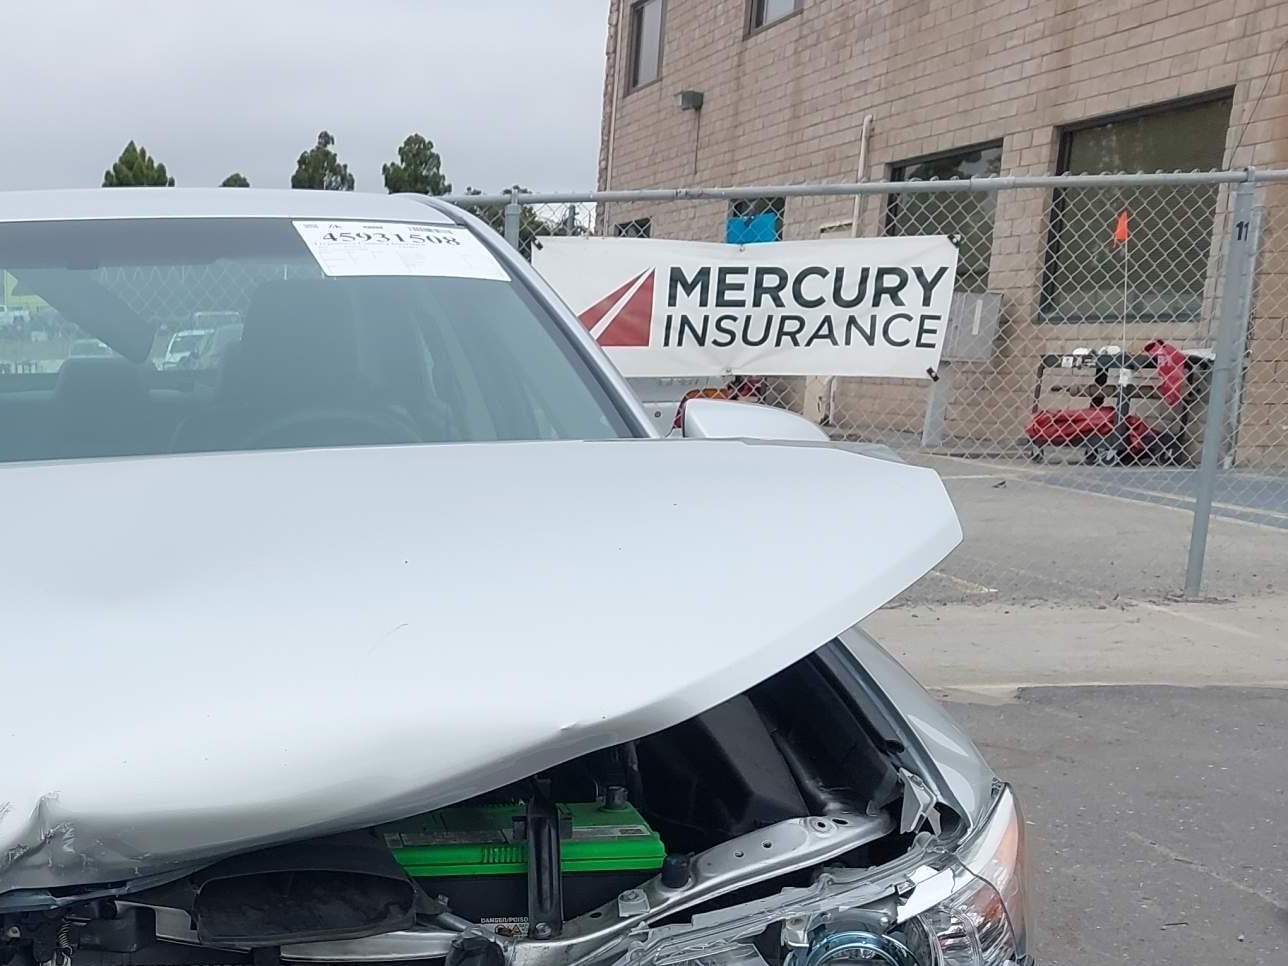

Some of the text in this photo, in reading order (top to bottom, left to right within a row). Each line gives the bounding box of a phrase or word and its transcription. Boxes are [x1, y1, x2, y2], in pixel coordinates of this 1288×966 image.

[322, 232, 460, 246] 45931508
[667, 265, 950, 309] MERCURY
[662, 313, 942, 349] INSURANCE
